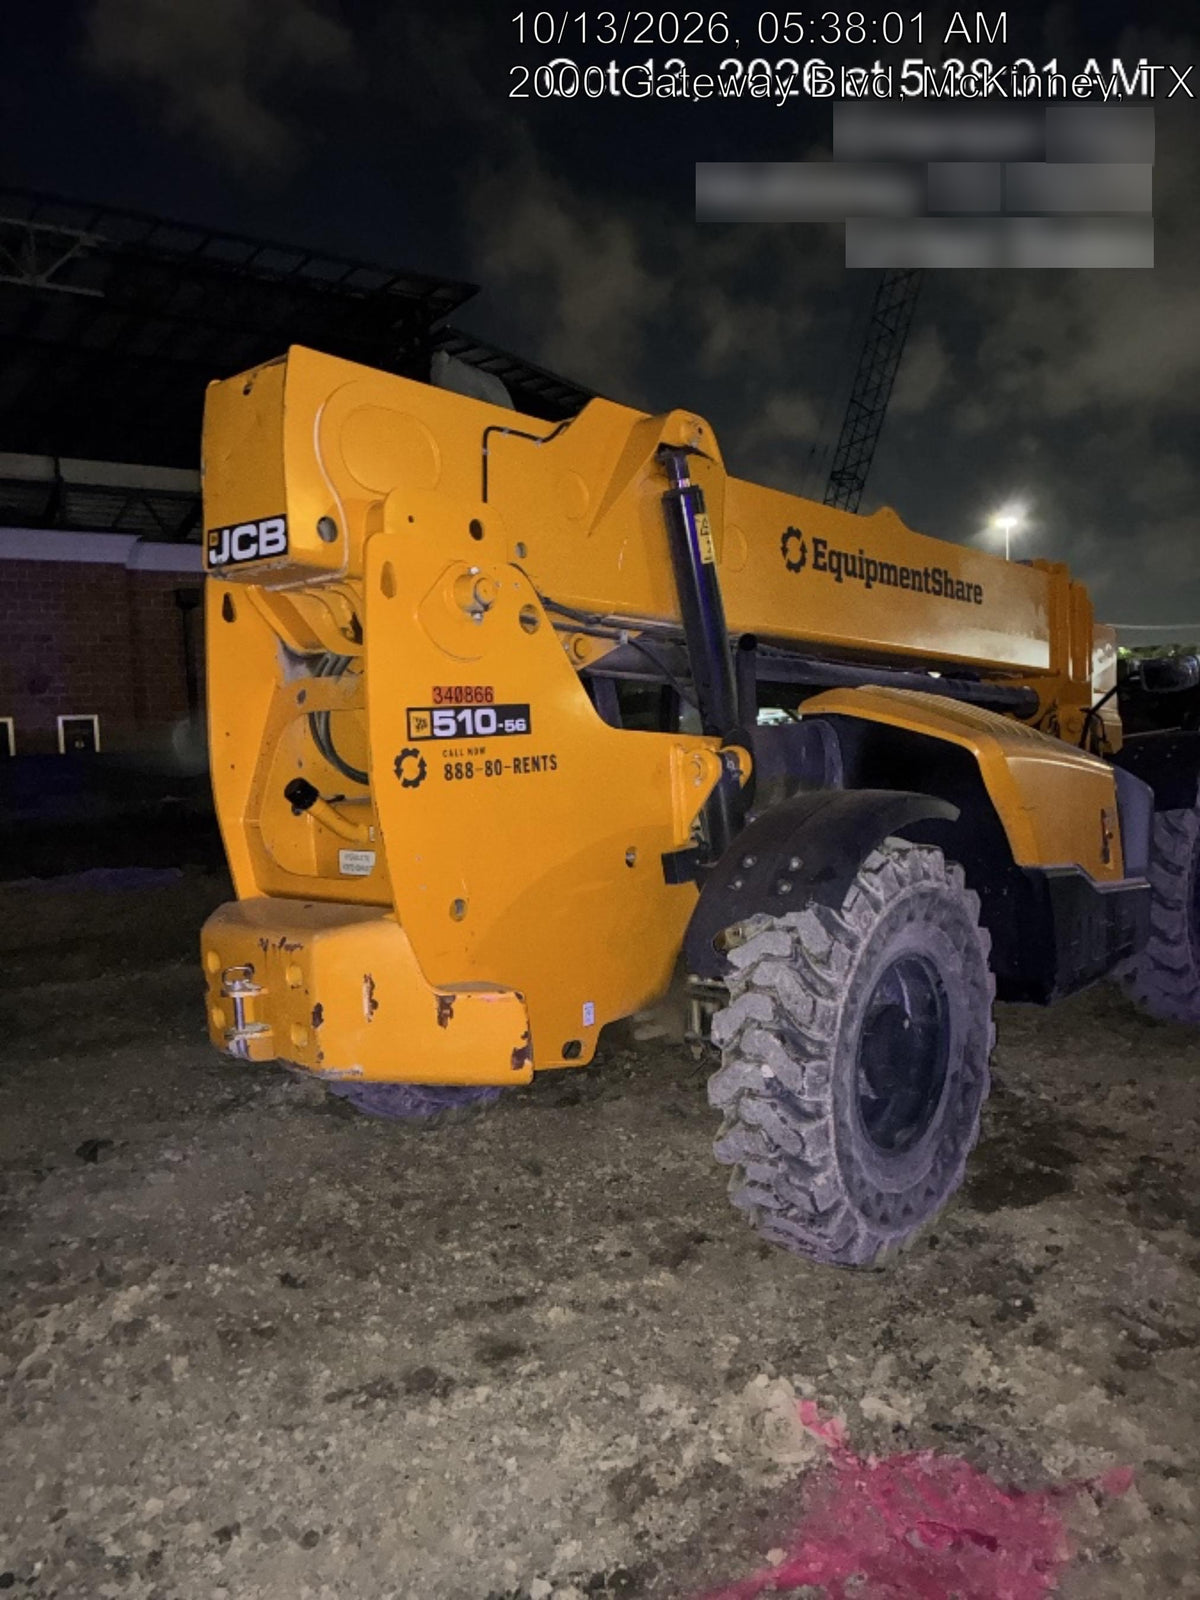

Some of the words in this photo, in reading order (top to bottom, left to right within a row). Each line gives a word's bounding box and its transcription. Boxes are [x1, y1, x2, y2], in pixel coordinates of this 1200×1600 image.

[208, 518, 287, 565] JCB
[811, 536, 984, 605] EquipmentShare
[432, 686, 495, 704] 340866
[442, 748, 464, 758] CALL
[467, 746, 486, 756] NOW
[443, 754, 558, 782] 888-80-RENTS
